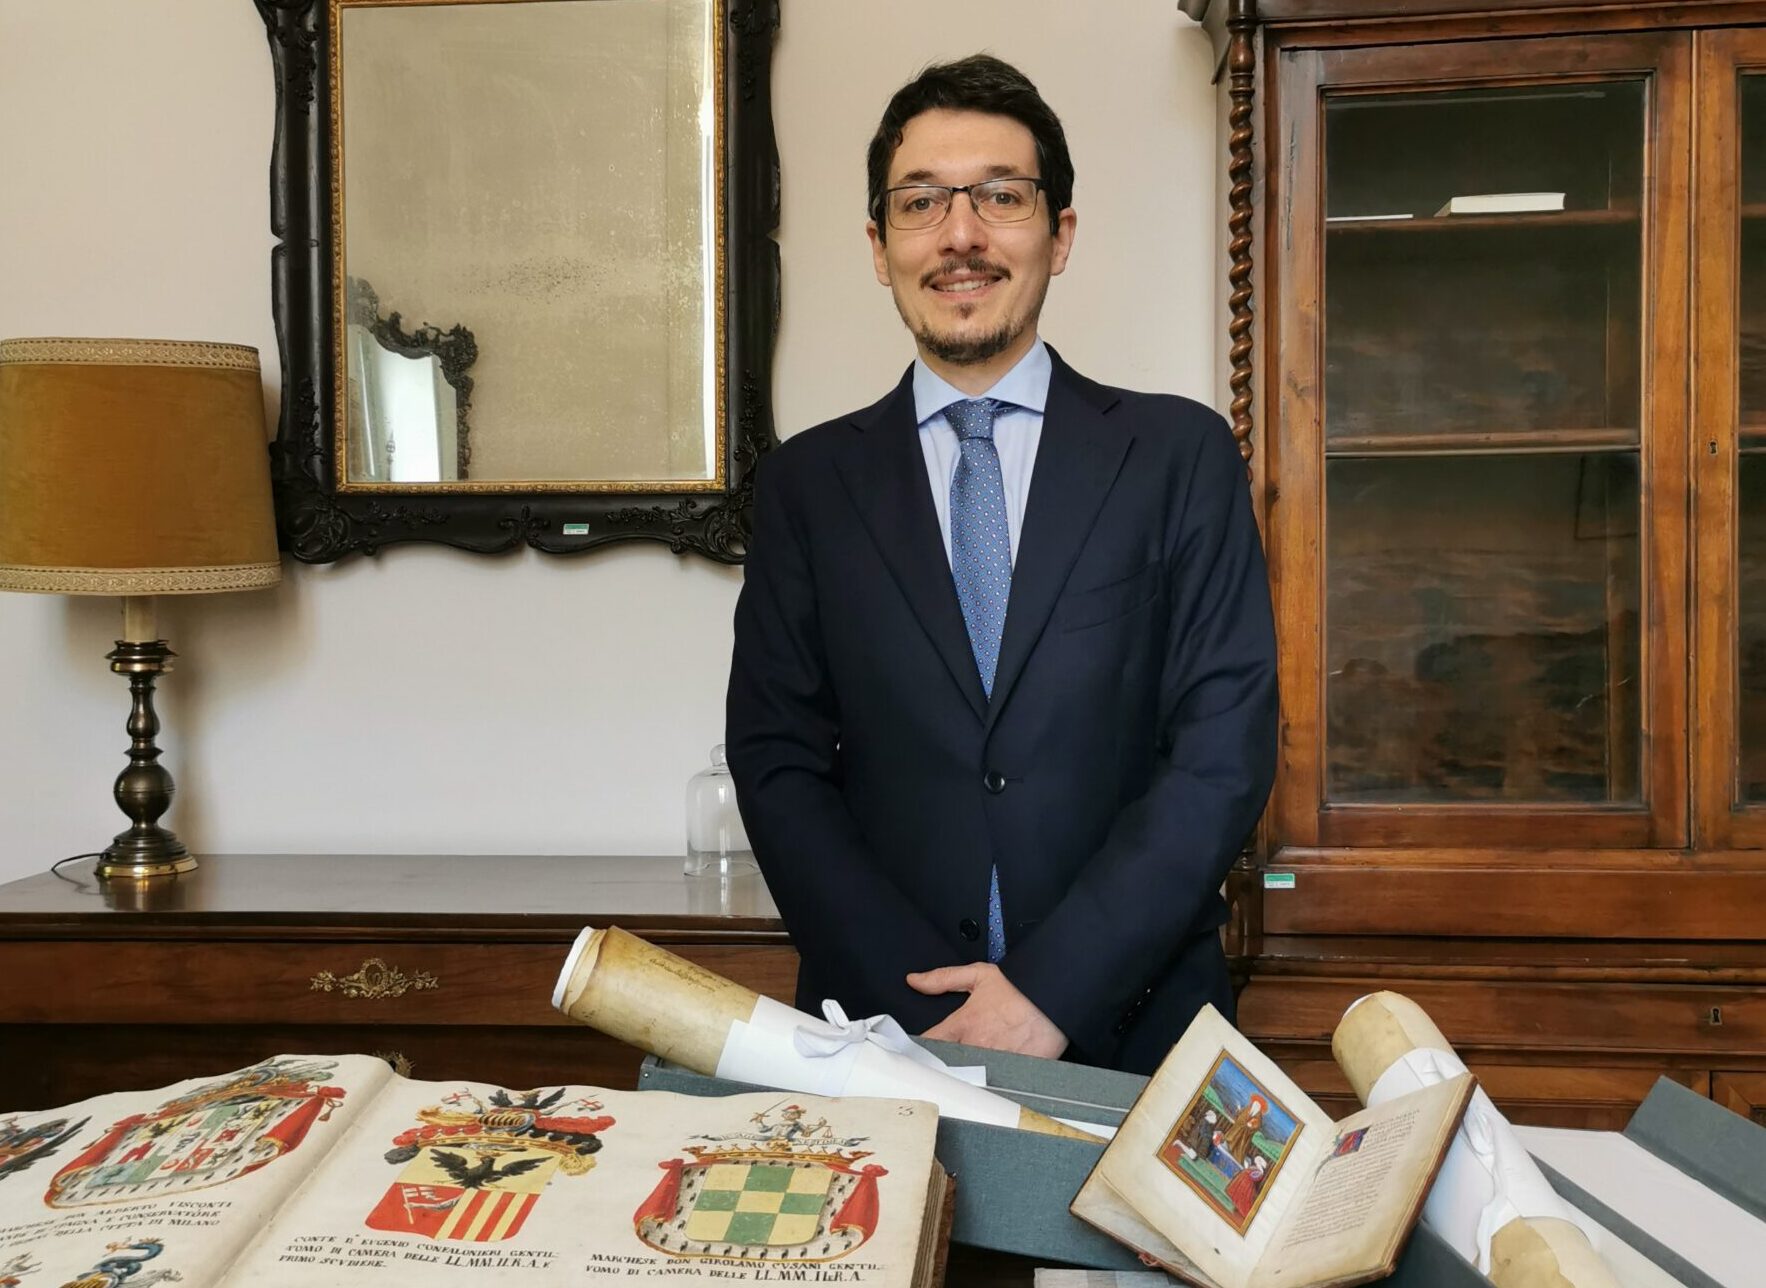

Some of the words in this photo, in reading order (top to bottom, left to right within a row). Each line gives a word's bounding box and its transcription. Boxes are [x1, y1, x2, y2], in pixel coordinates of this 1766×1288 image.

[168, 1218, 221, 1226] MILANO
[348, 1248, 397, 1258] CAMERA
[404, 1252, 441, 1264] DELLE
[416, 1242, 502, 1257] CONFALONIERI
[279, 1254, 317, 1264] PRIMO
[591, 1253, 657, 1266] MARCHESE
[699, 1258, 765, 1269] GIROLAMO
[627, 1268, 641, 1276] DI
[646, 1267, 703, 1276] CAMERA
[709, 1269, 748, 1280] DELLE
